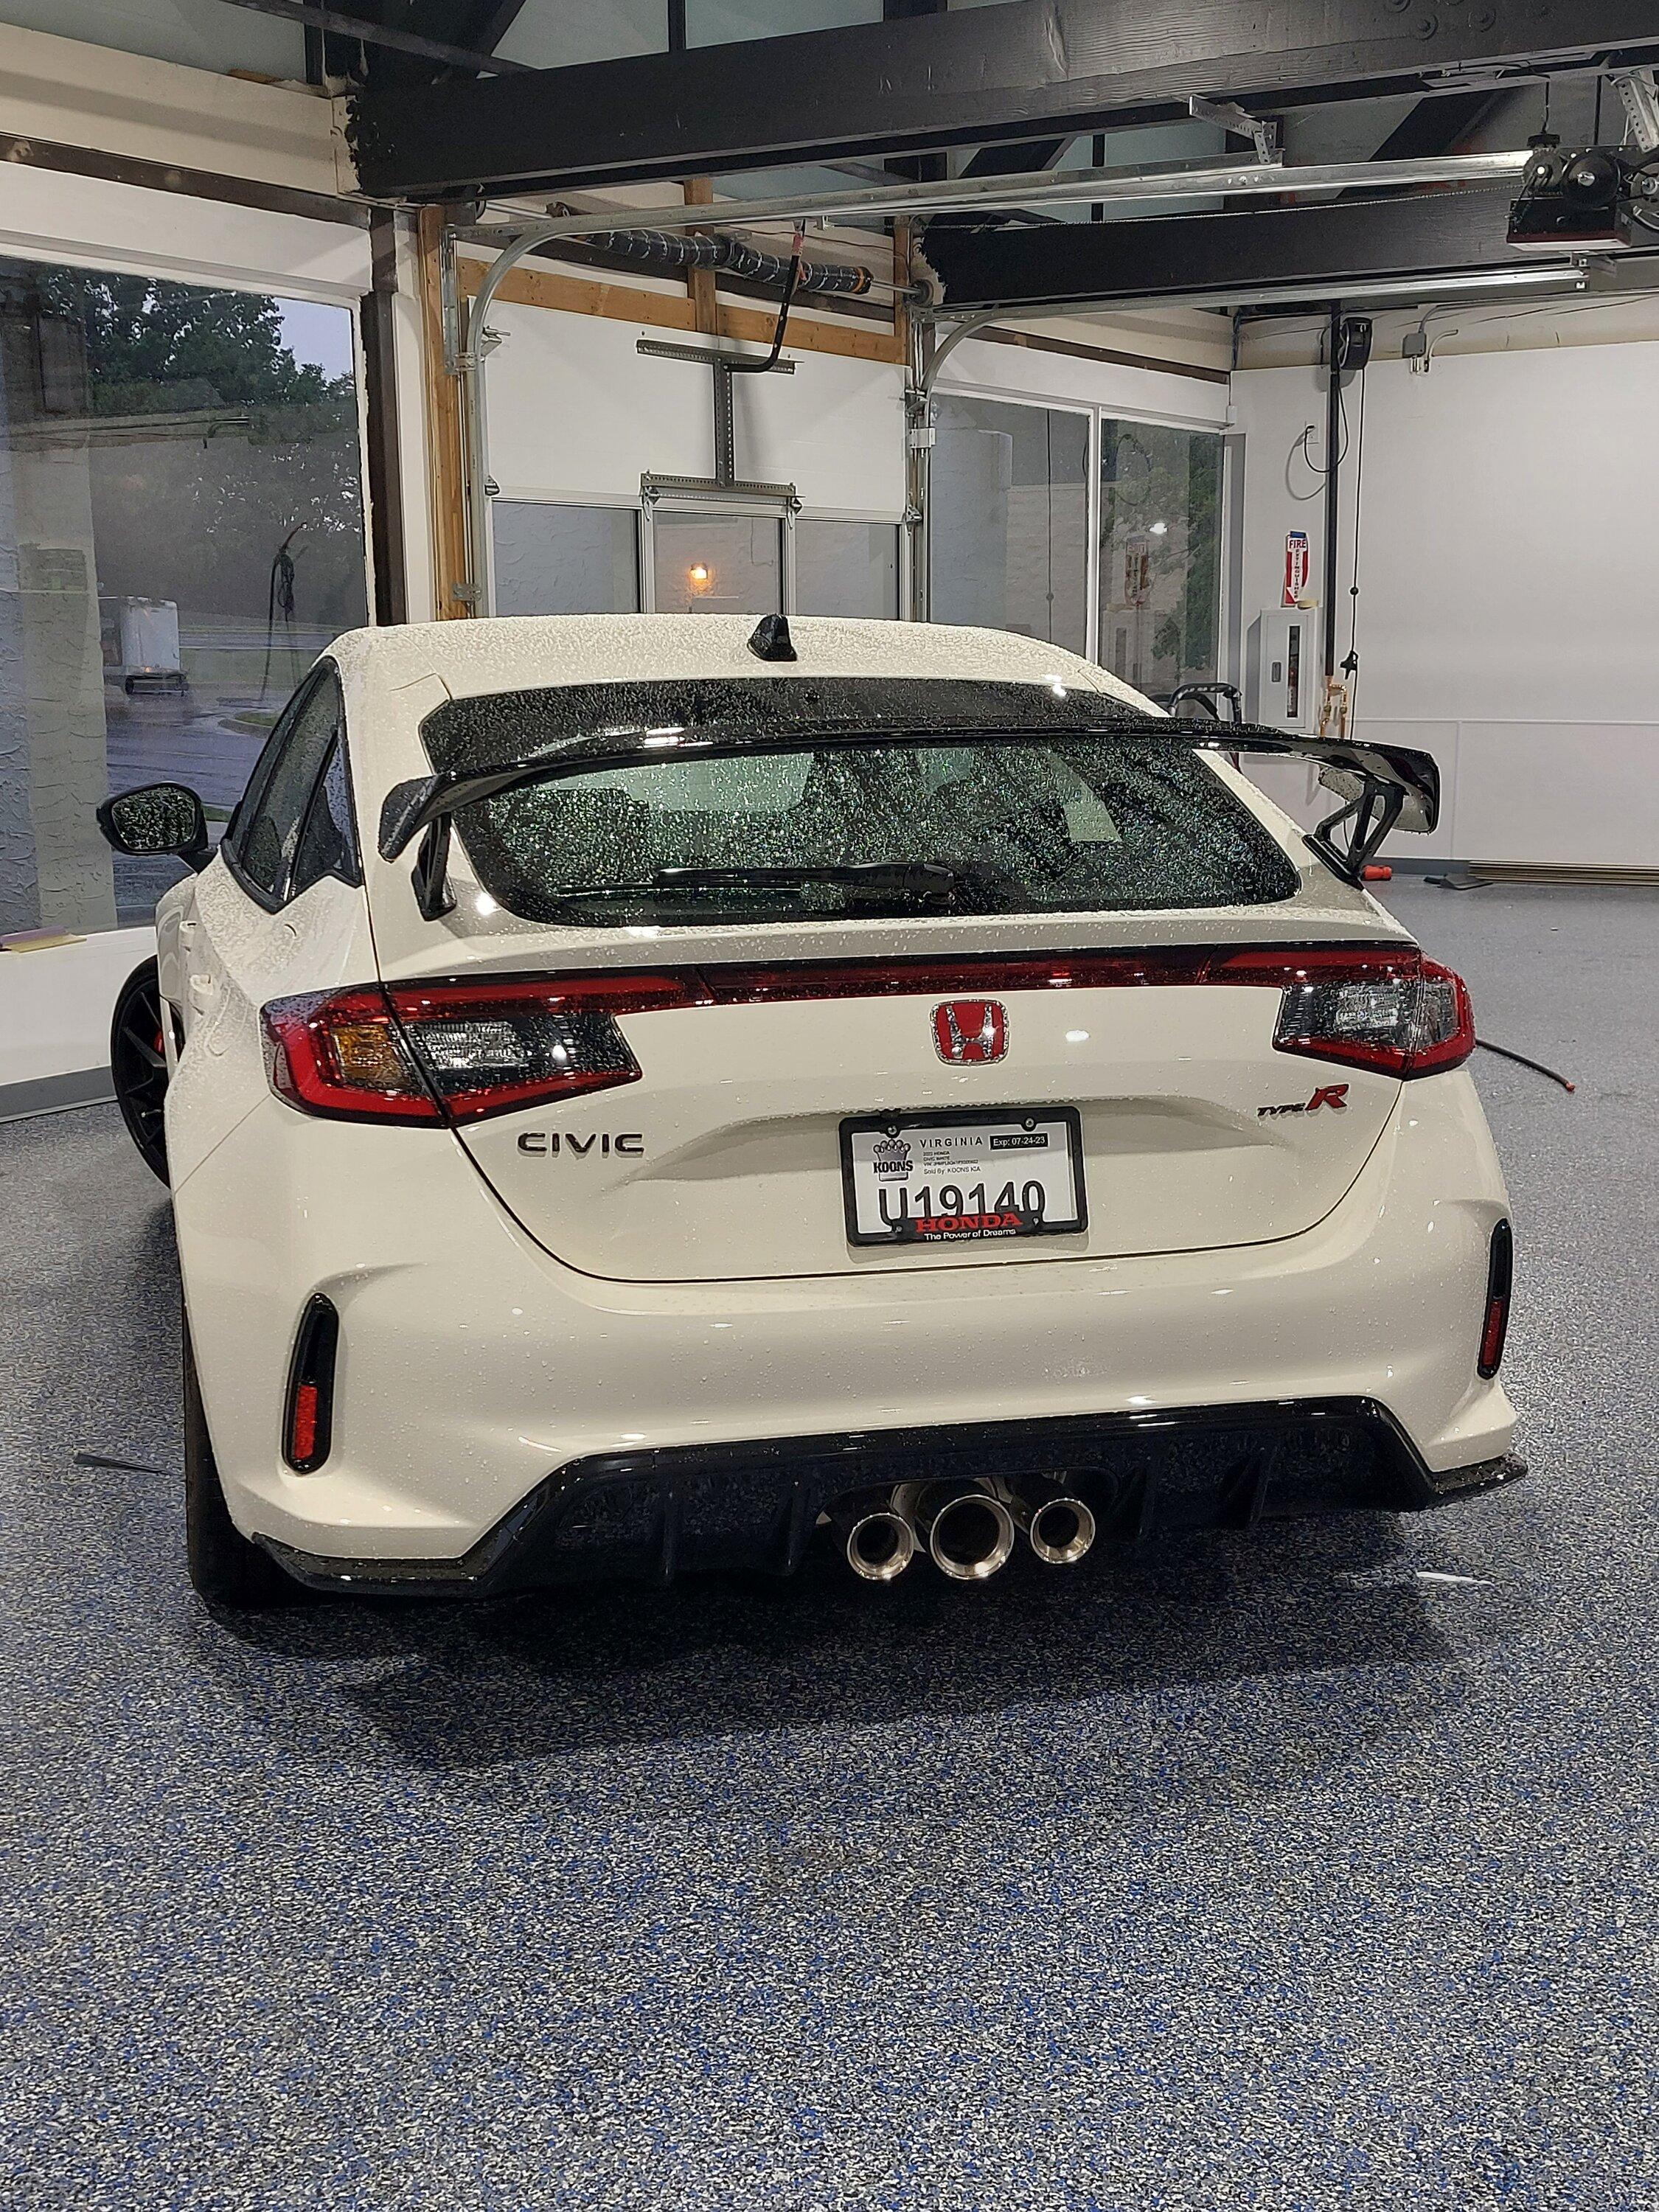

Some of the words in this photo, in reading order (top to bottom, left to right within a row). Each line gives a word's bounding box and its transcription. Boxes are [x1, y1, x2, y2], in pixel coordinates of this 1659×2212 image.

[1289, 540, 1307, 549] FIRE
[1257, 1102, 1306, 1117] TYPE
[1304, 1083, 1349, 1111] R
[517, 1133, 644, 1154] CIVIC
[919, 1136, 983, 1148] VIRGINIA
[993, 1138, 1010, 1147] Exp:
[1012, 1136, 1046, 1145] 07-24-23
[873, 1160, 914, 1174] KOONS
[878, 1180, 1046, 1225] U19140
[916, 1213, 1023, 1232] HONDA
[924, 1233, 942, 1241] The
[943, 1231, 971, 1239] Power
[972, 1229, 981, 1237] of
[983, 1228, 1017, 1237] Dreams
